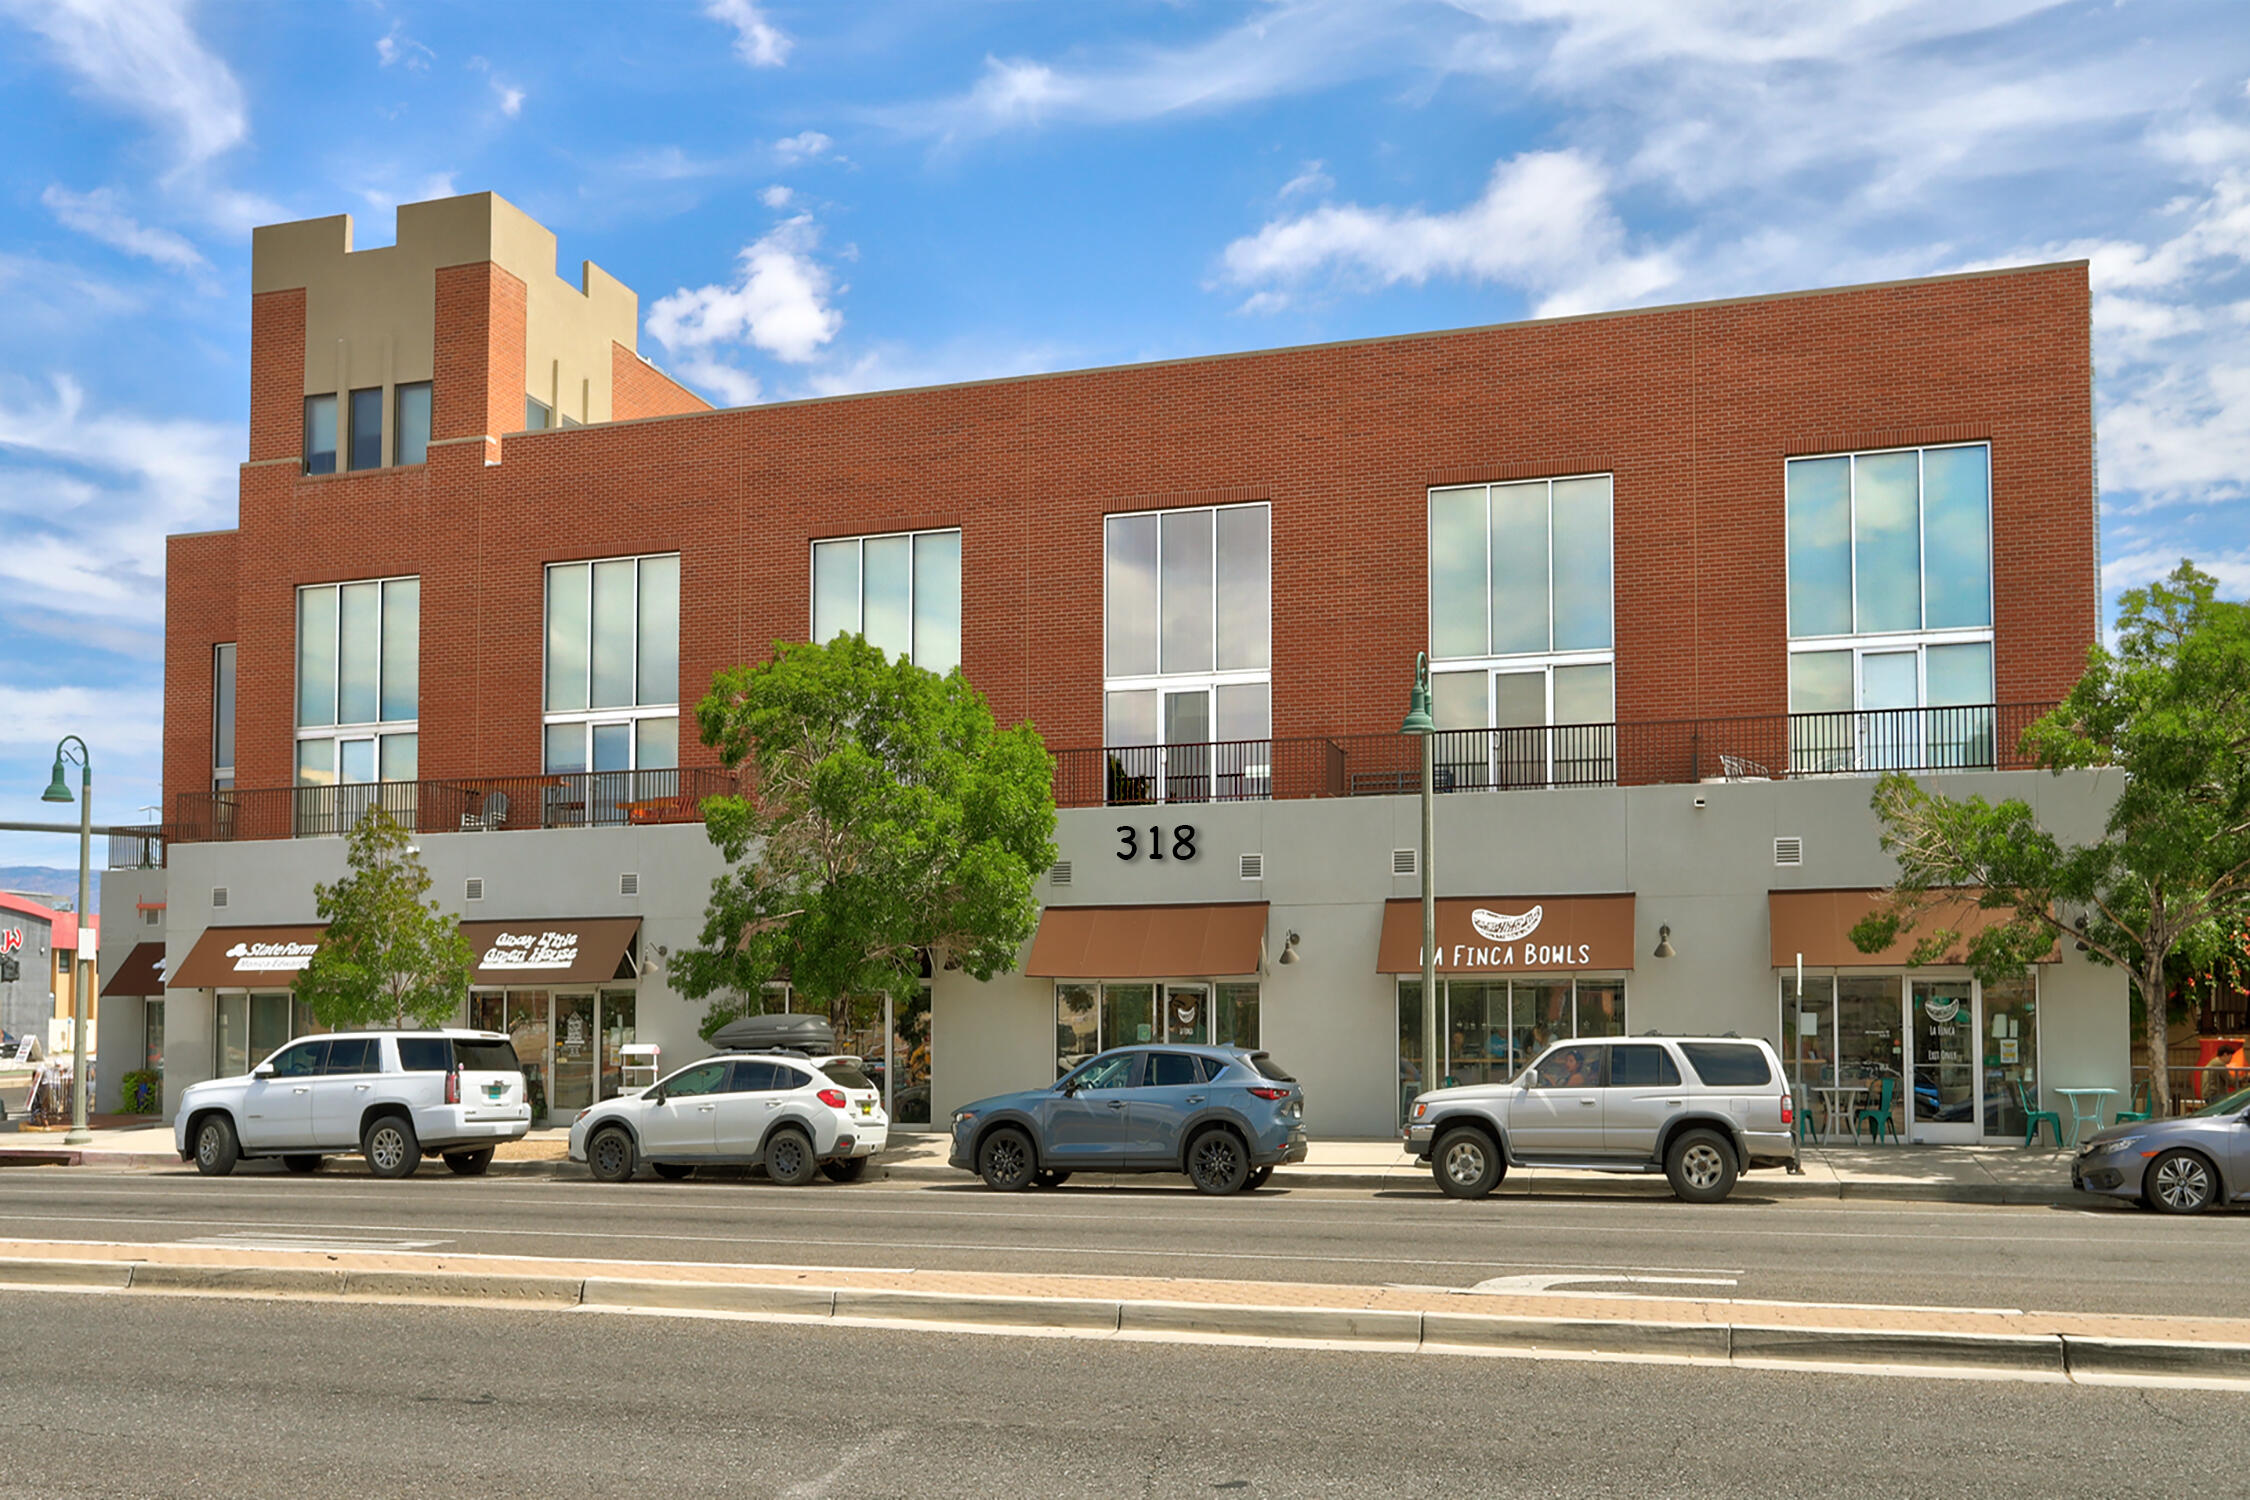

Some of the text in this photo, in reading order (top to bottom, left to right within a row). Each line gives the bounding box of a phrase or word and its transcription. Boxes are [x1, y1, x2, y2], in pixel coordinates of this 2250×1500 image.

[1116, 824, 1196, 860] 318
[483, 947, 578, 963] Green House
